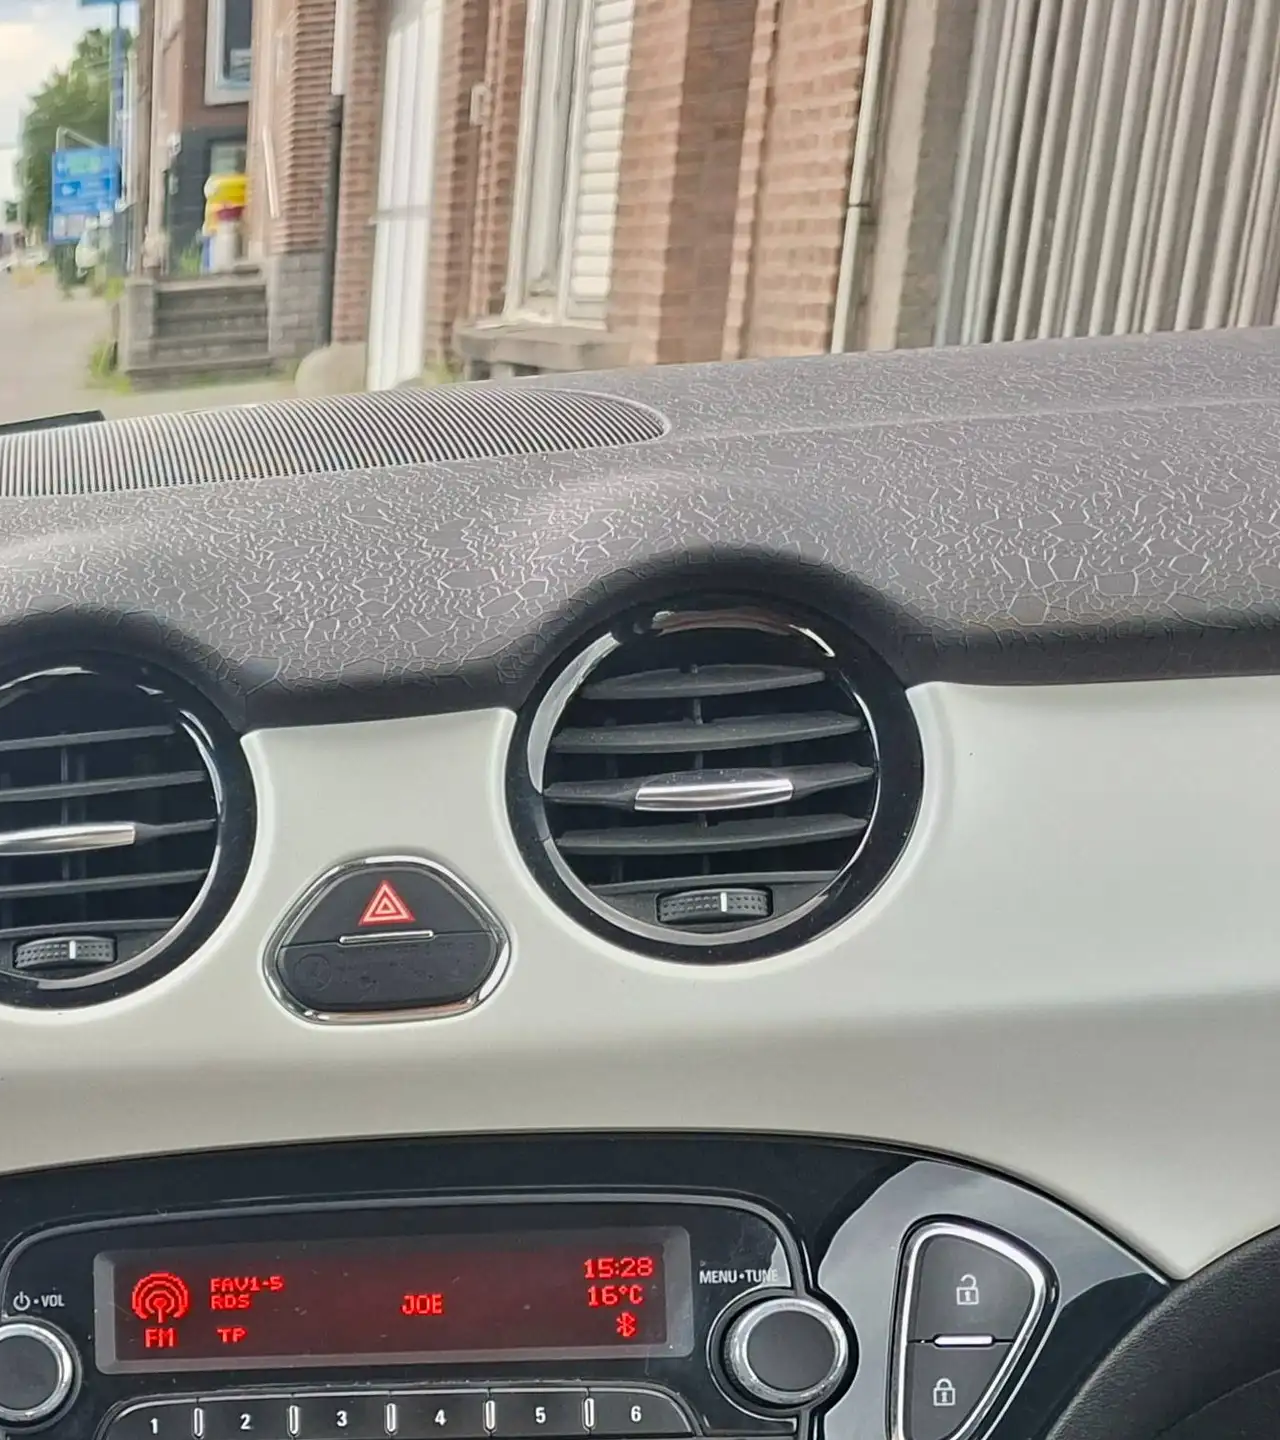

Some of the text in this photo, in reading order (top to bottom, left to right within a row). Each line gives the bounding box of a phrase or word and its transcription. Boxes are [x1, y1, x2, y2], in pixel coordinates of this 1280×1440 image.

[583, 1256, 653, 1278] 15:28
[210, 1276, 284, 1293] FAV1-5
[211, 1294, 251, 1311] RDS
[401, 1294, 443, 1316] JOE
[588, 1285, 643, 1307] 16°C
[145, 1328, 176, 1348] FM
[217, 1327, 247, 1343] TP
[150, 1406, 641, 1435] 1 2 3 4 5 6
